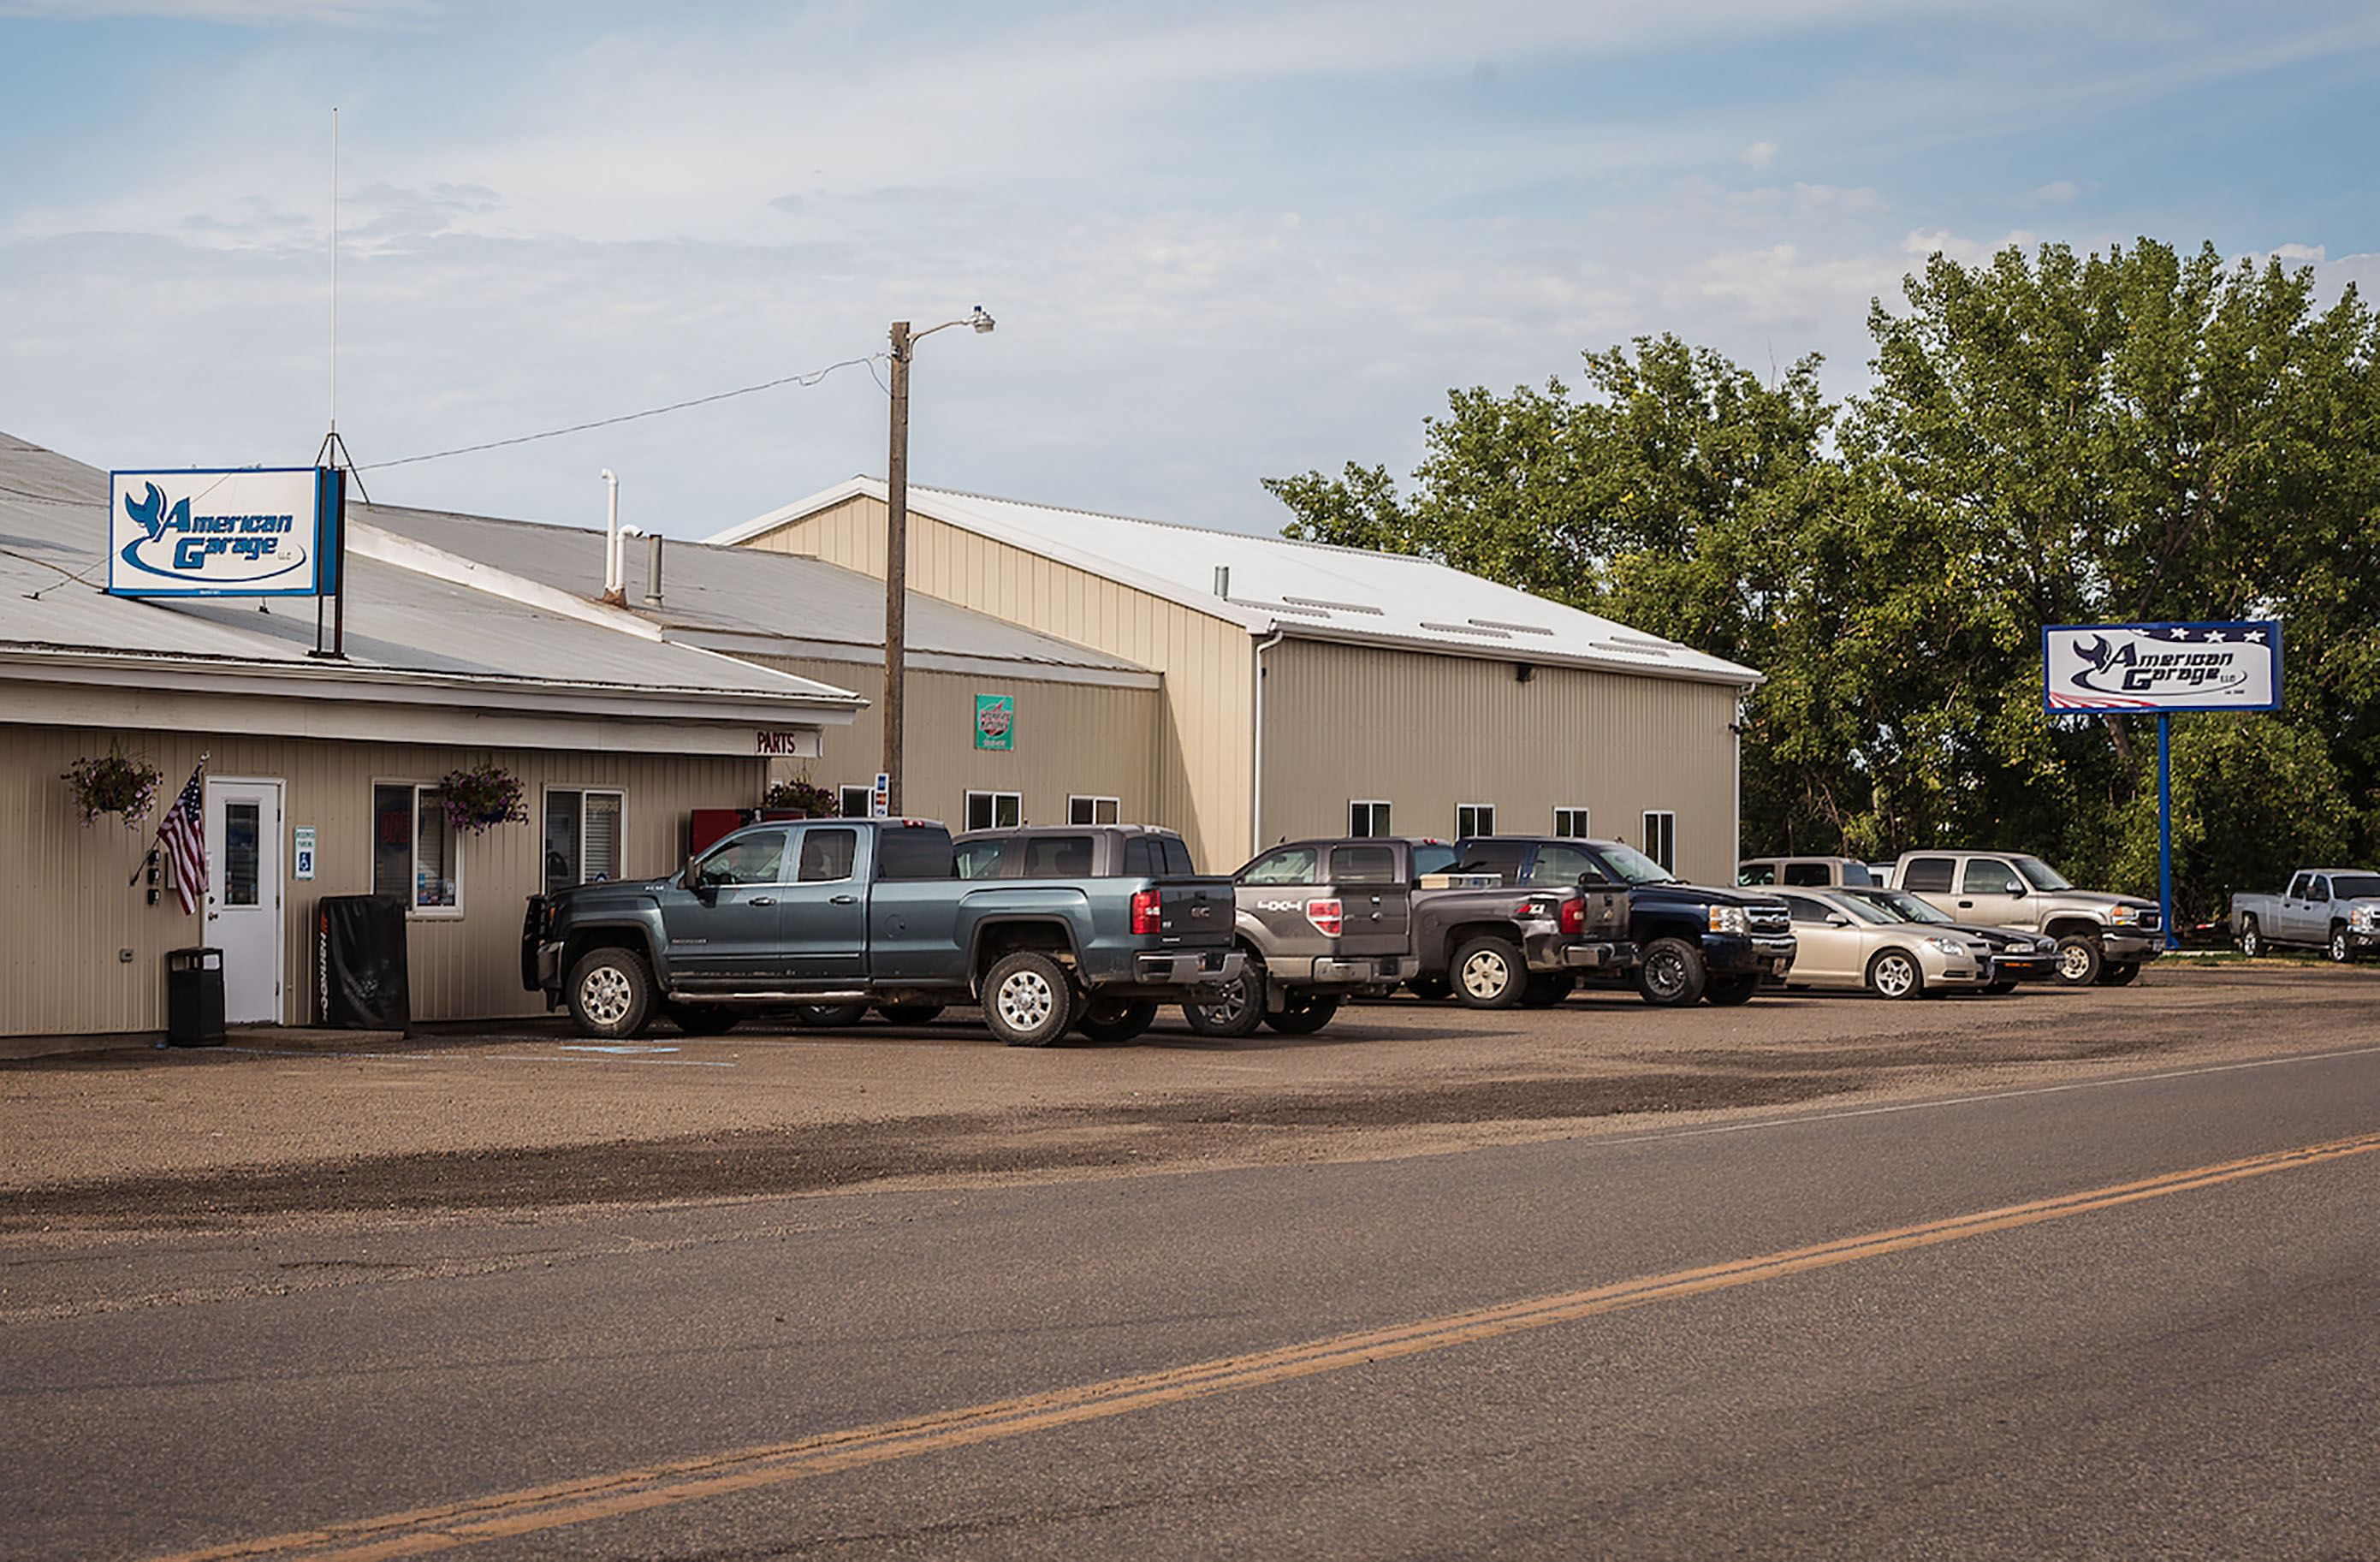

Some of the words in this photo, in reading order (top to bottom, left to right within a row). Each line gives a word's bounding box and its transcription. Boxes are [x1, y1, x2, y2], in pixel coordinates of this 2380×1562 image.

[152, 496, 294, 542] American
[174, 537, 278, 569] Garage
[2099, 642, 2235, 674] American
[2122, 668, 2220, 690] Garage
[757, 732, 796, 754] PARTS
[381, 811, 410, 843] OPE
